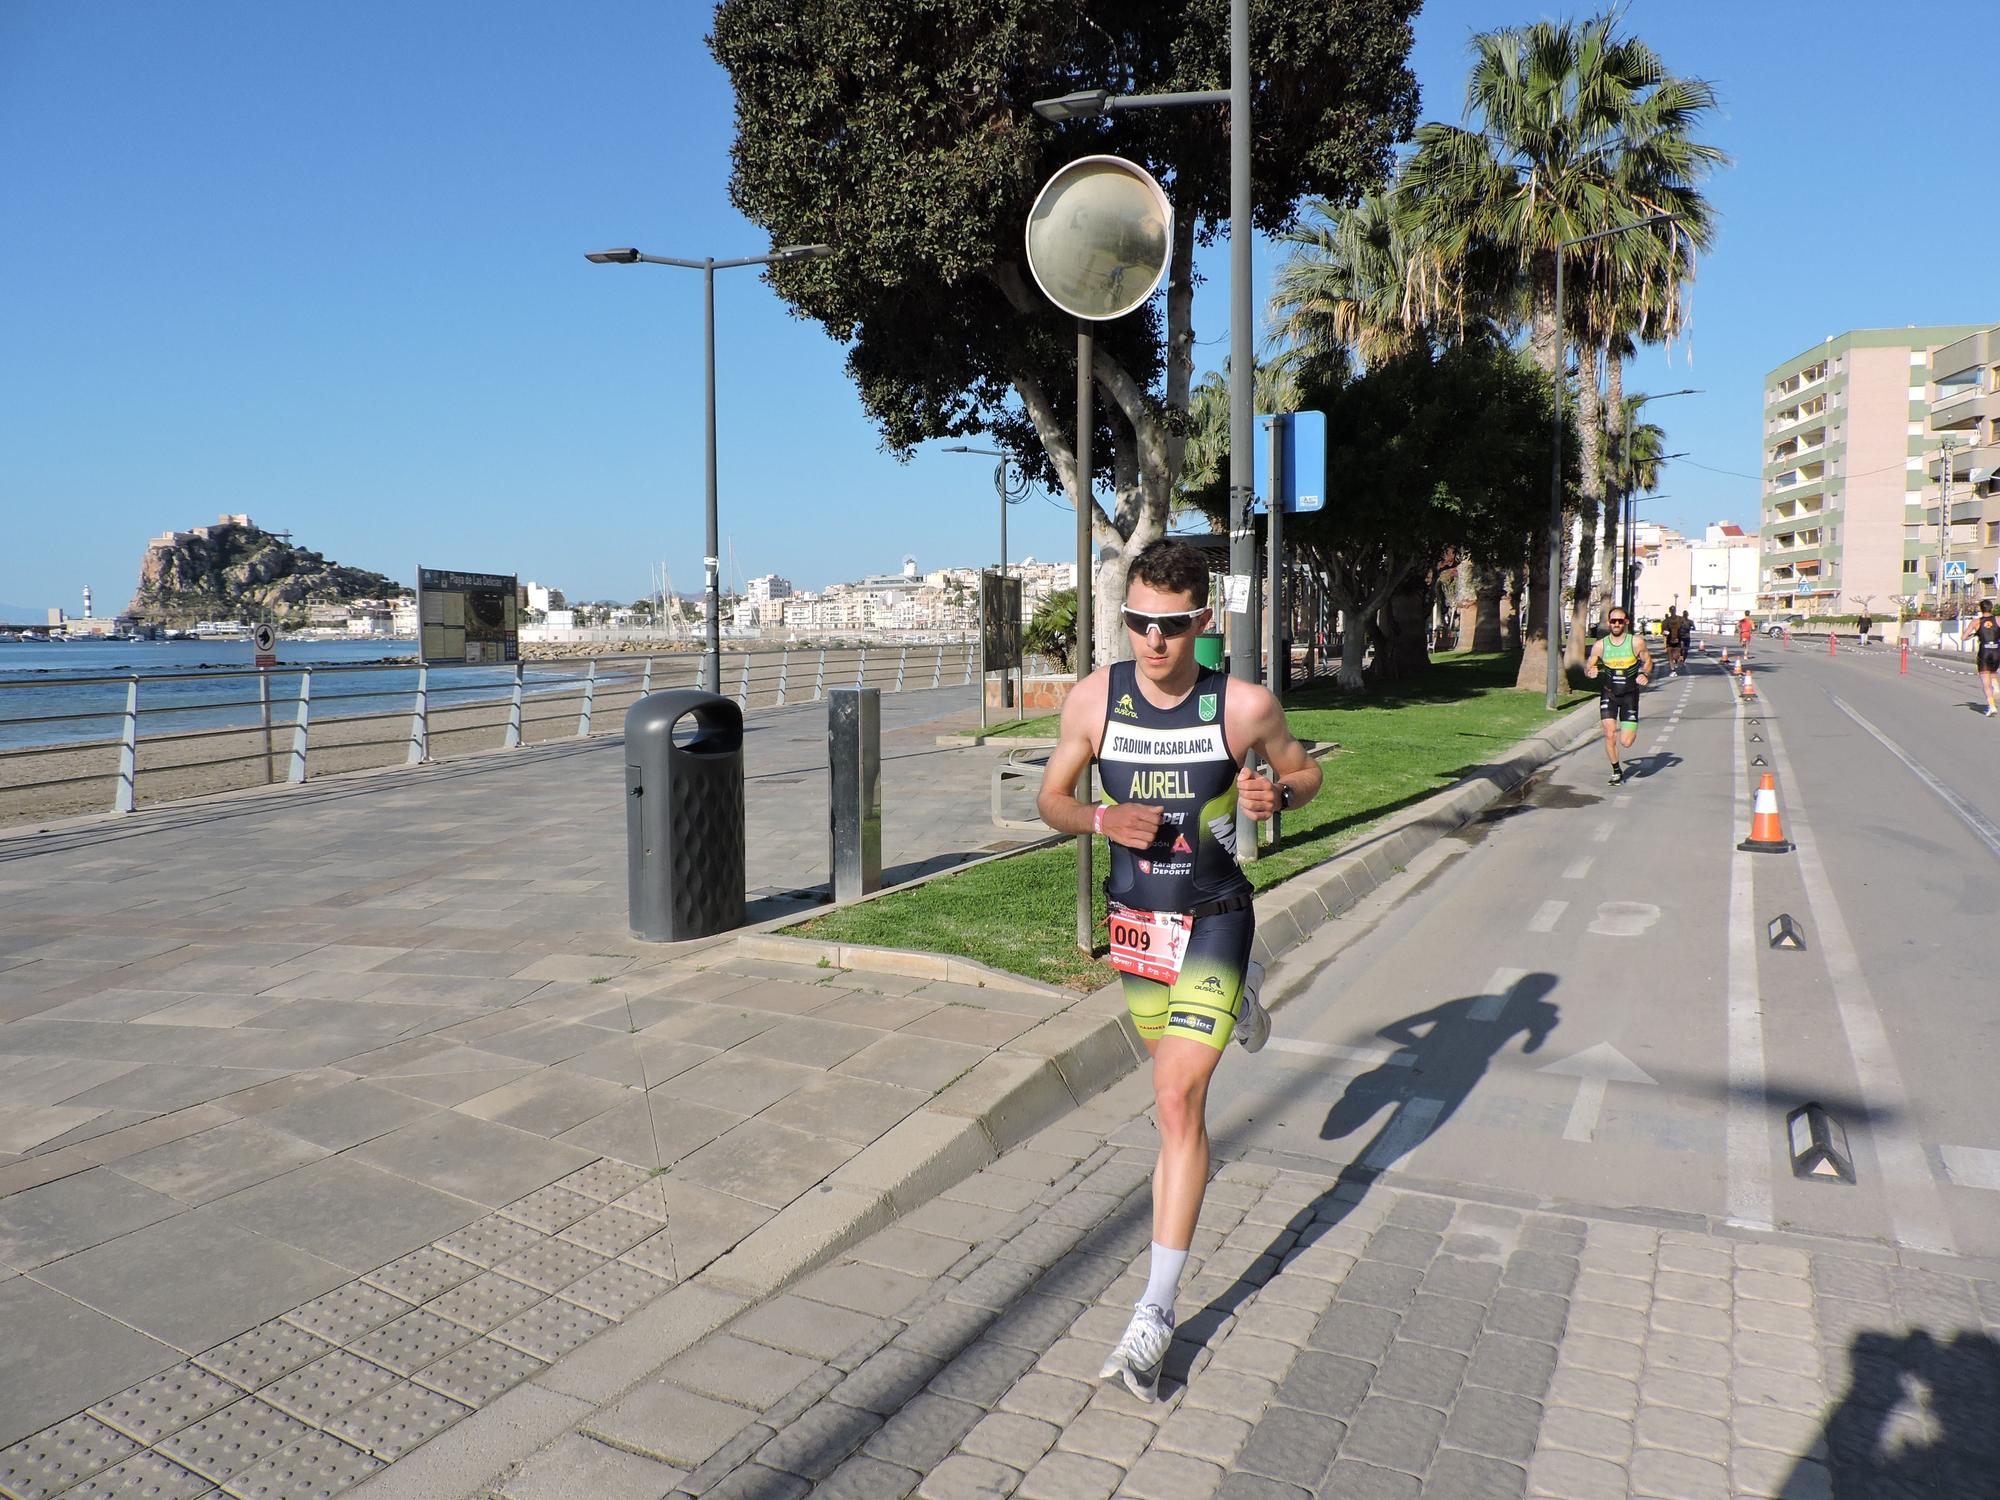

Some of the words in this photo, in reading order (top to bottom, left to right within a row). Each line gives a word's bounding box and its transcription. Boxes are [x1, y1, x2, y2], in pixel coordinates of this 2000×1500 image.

[1113, 736, 1151, 755] STADIUM
[1154, 738, 1213, 755] CASABLANCA
[1129, 770, 1195, 799] AURELL
[1162, 812, 1186, 825] PEI
[1153, 860, 1191, 870] Zaragoza
[1115, 924, 1151, 951] 009
